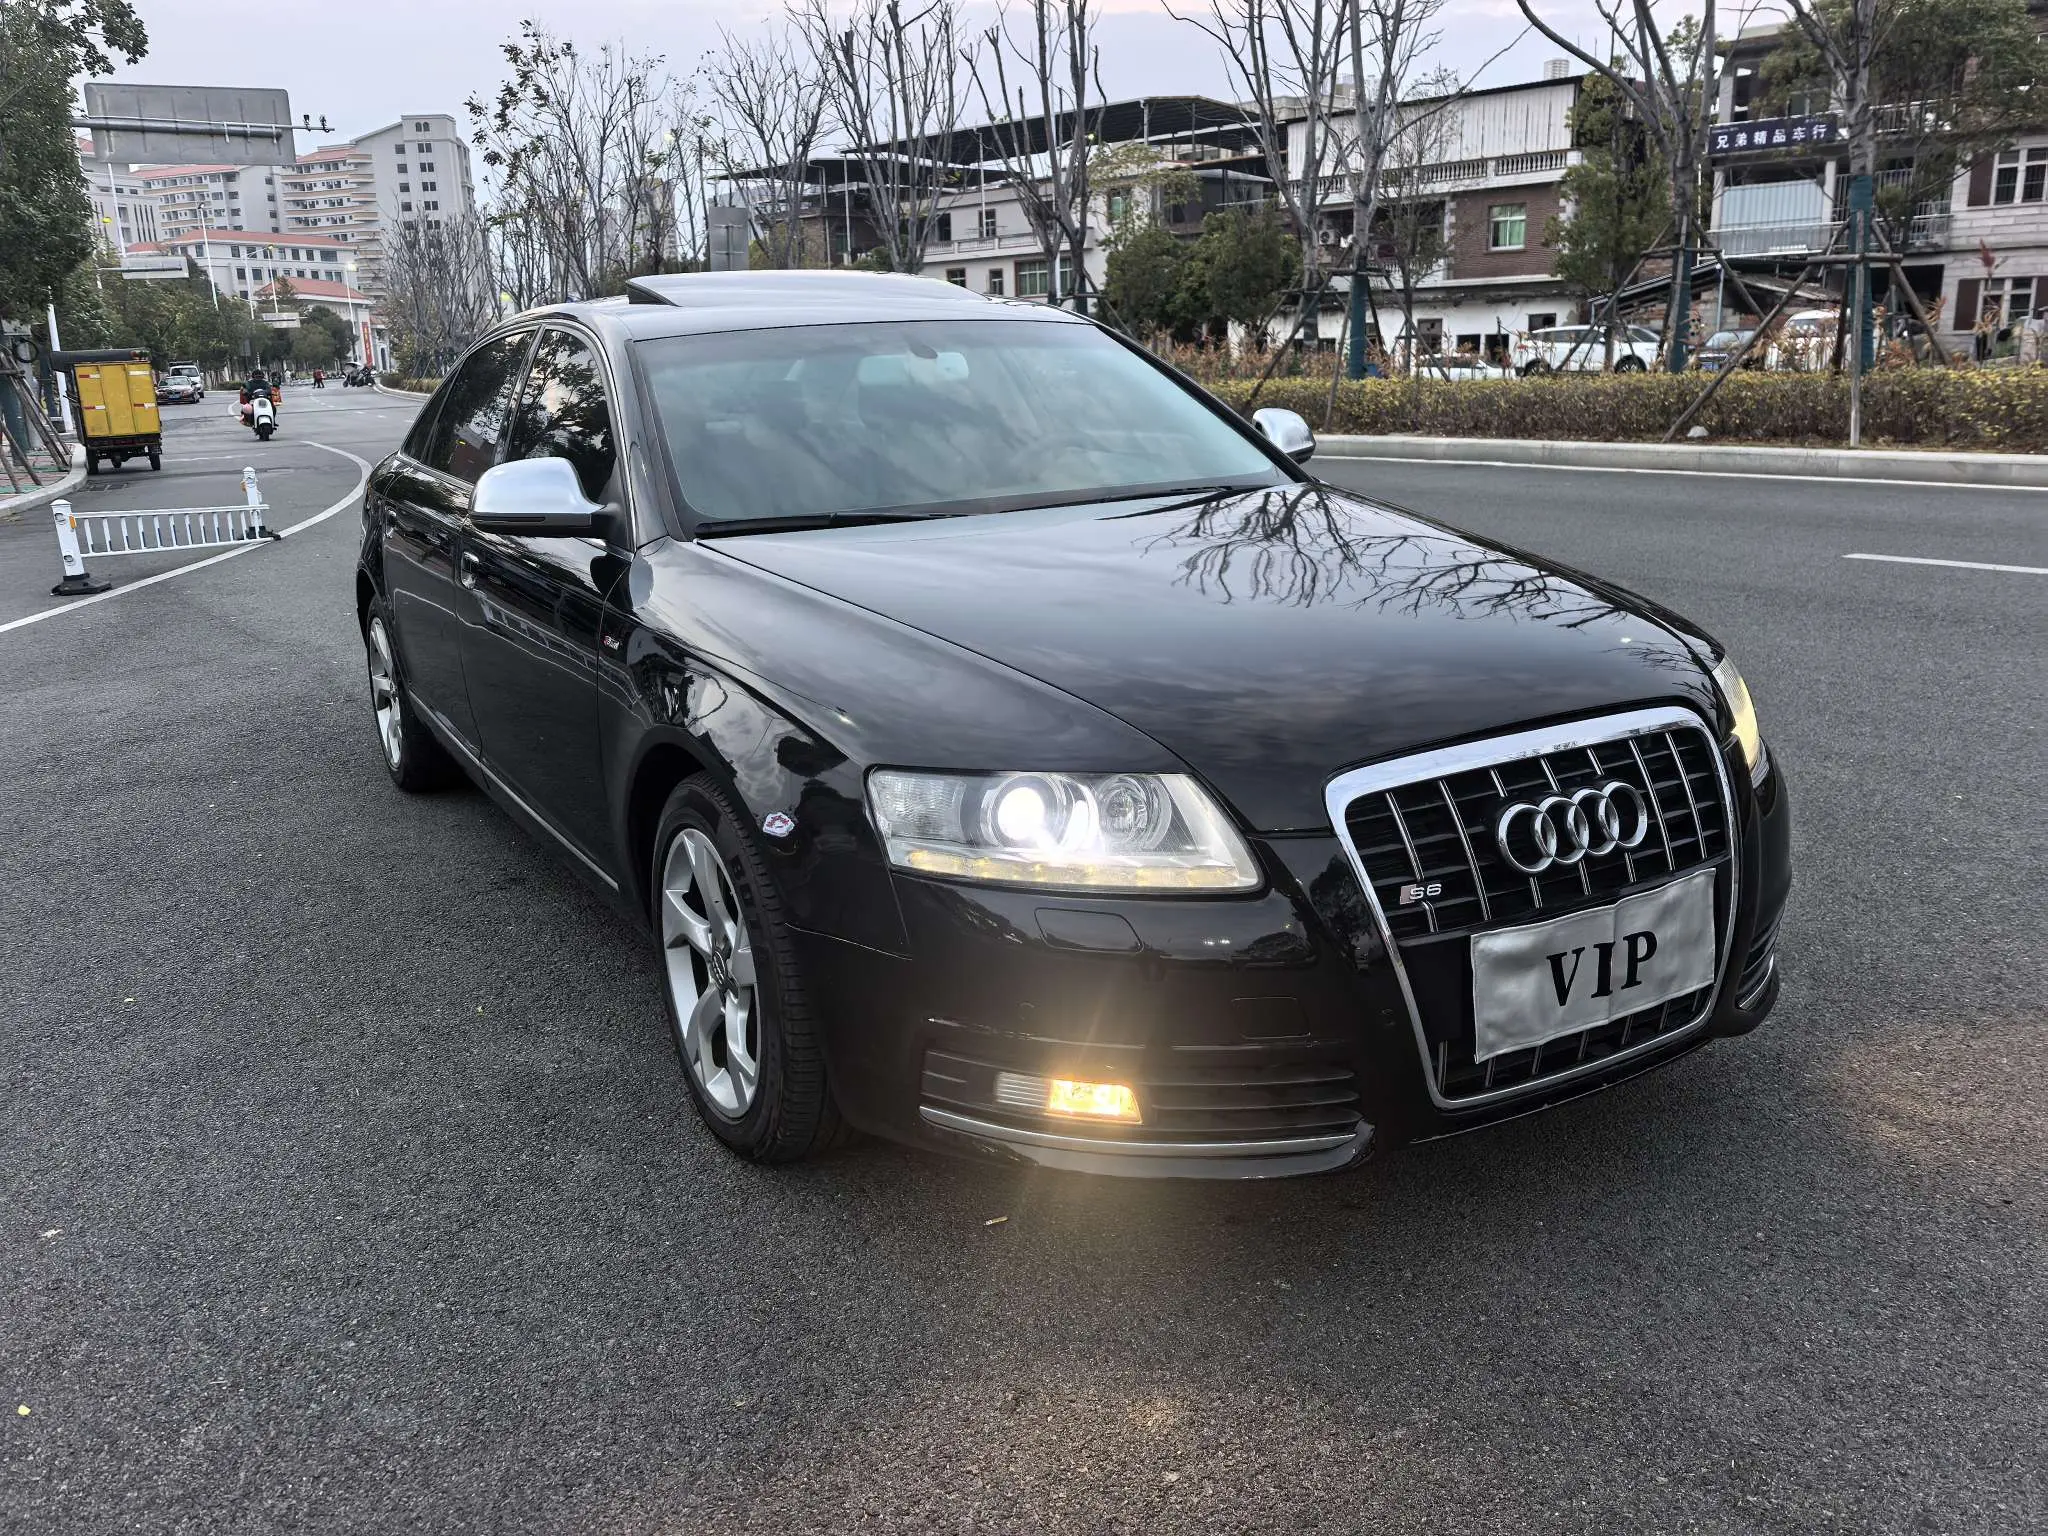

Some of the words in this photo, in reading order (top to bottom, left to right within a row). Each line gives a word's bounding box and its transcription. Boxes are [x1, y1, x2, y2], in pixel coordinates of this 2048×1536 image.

[1715, 124, 1827, 149] 兄弟精品车行
[1409, 883, 1442, 900] S6
[1546, 930, 1658, 1007] VIP
